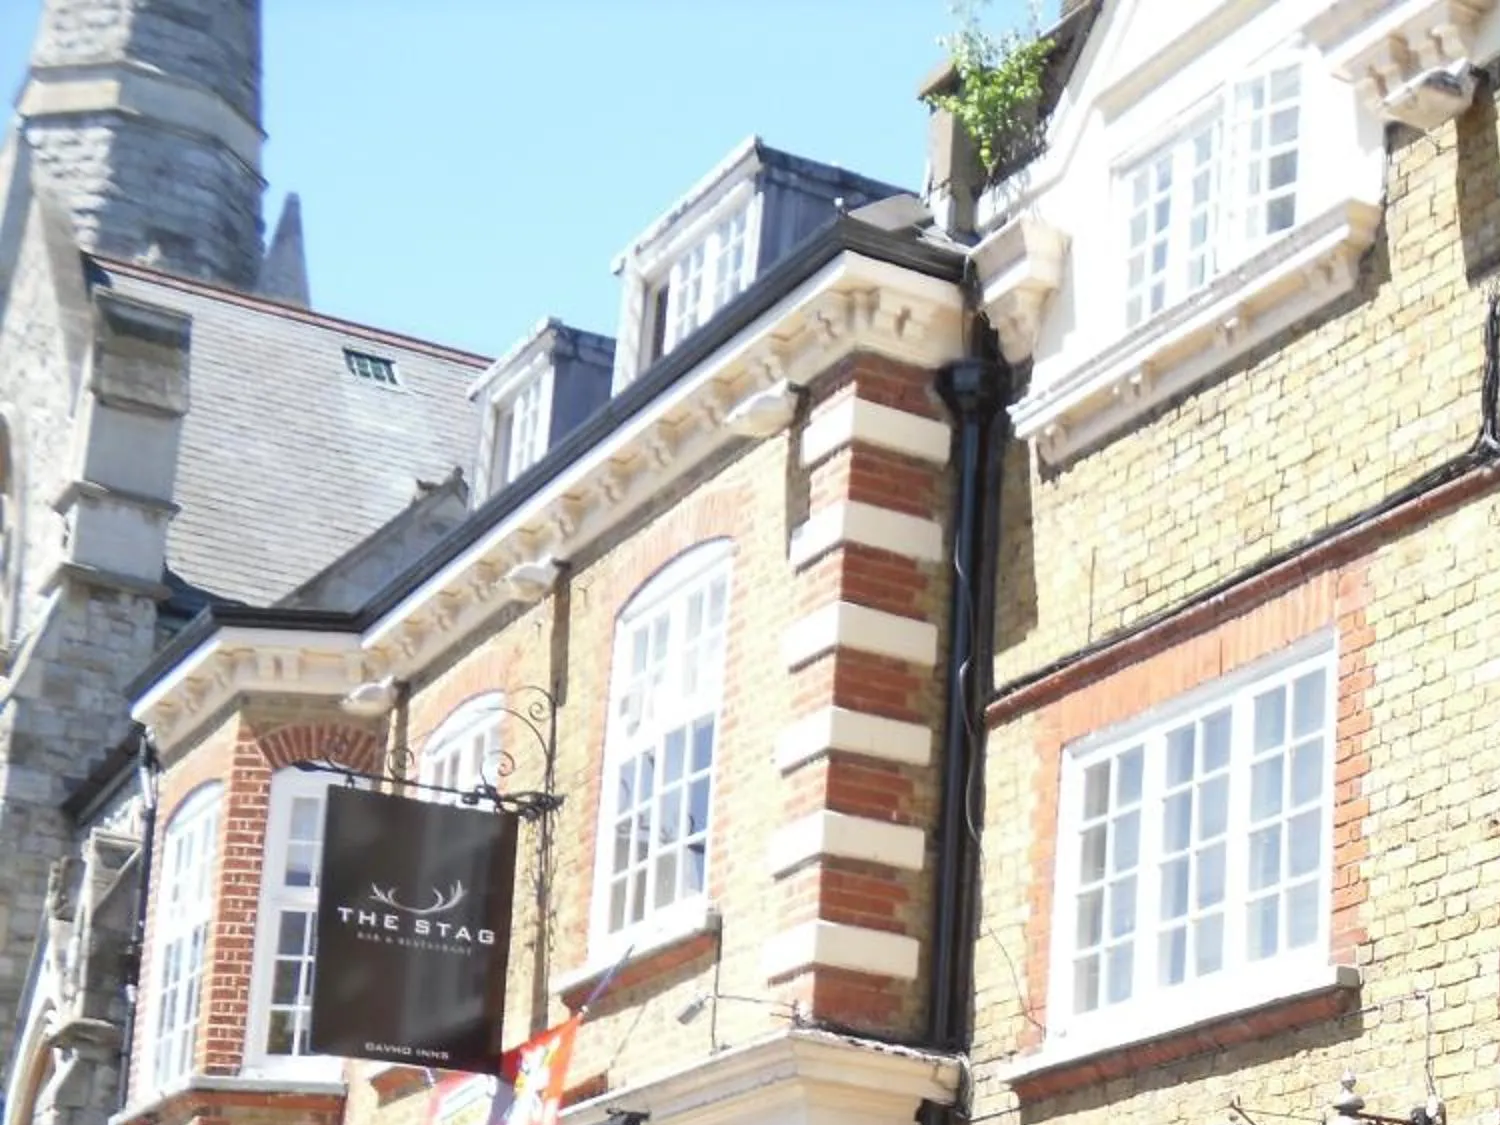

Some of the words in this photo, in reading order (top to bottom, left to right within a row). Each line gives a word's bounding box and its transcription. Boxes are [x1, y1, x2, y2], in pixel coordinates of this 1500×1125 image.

[336, 906, 400, 931] THE
[414, 918, 496, 945] STAG
[415, 1048, 450, 1060] INNS
